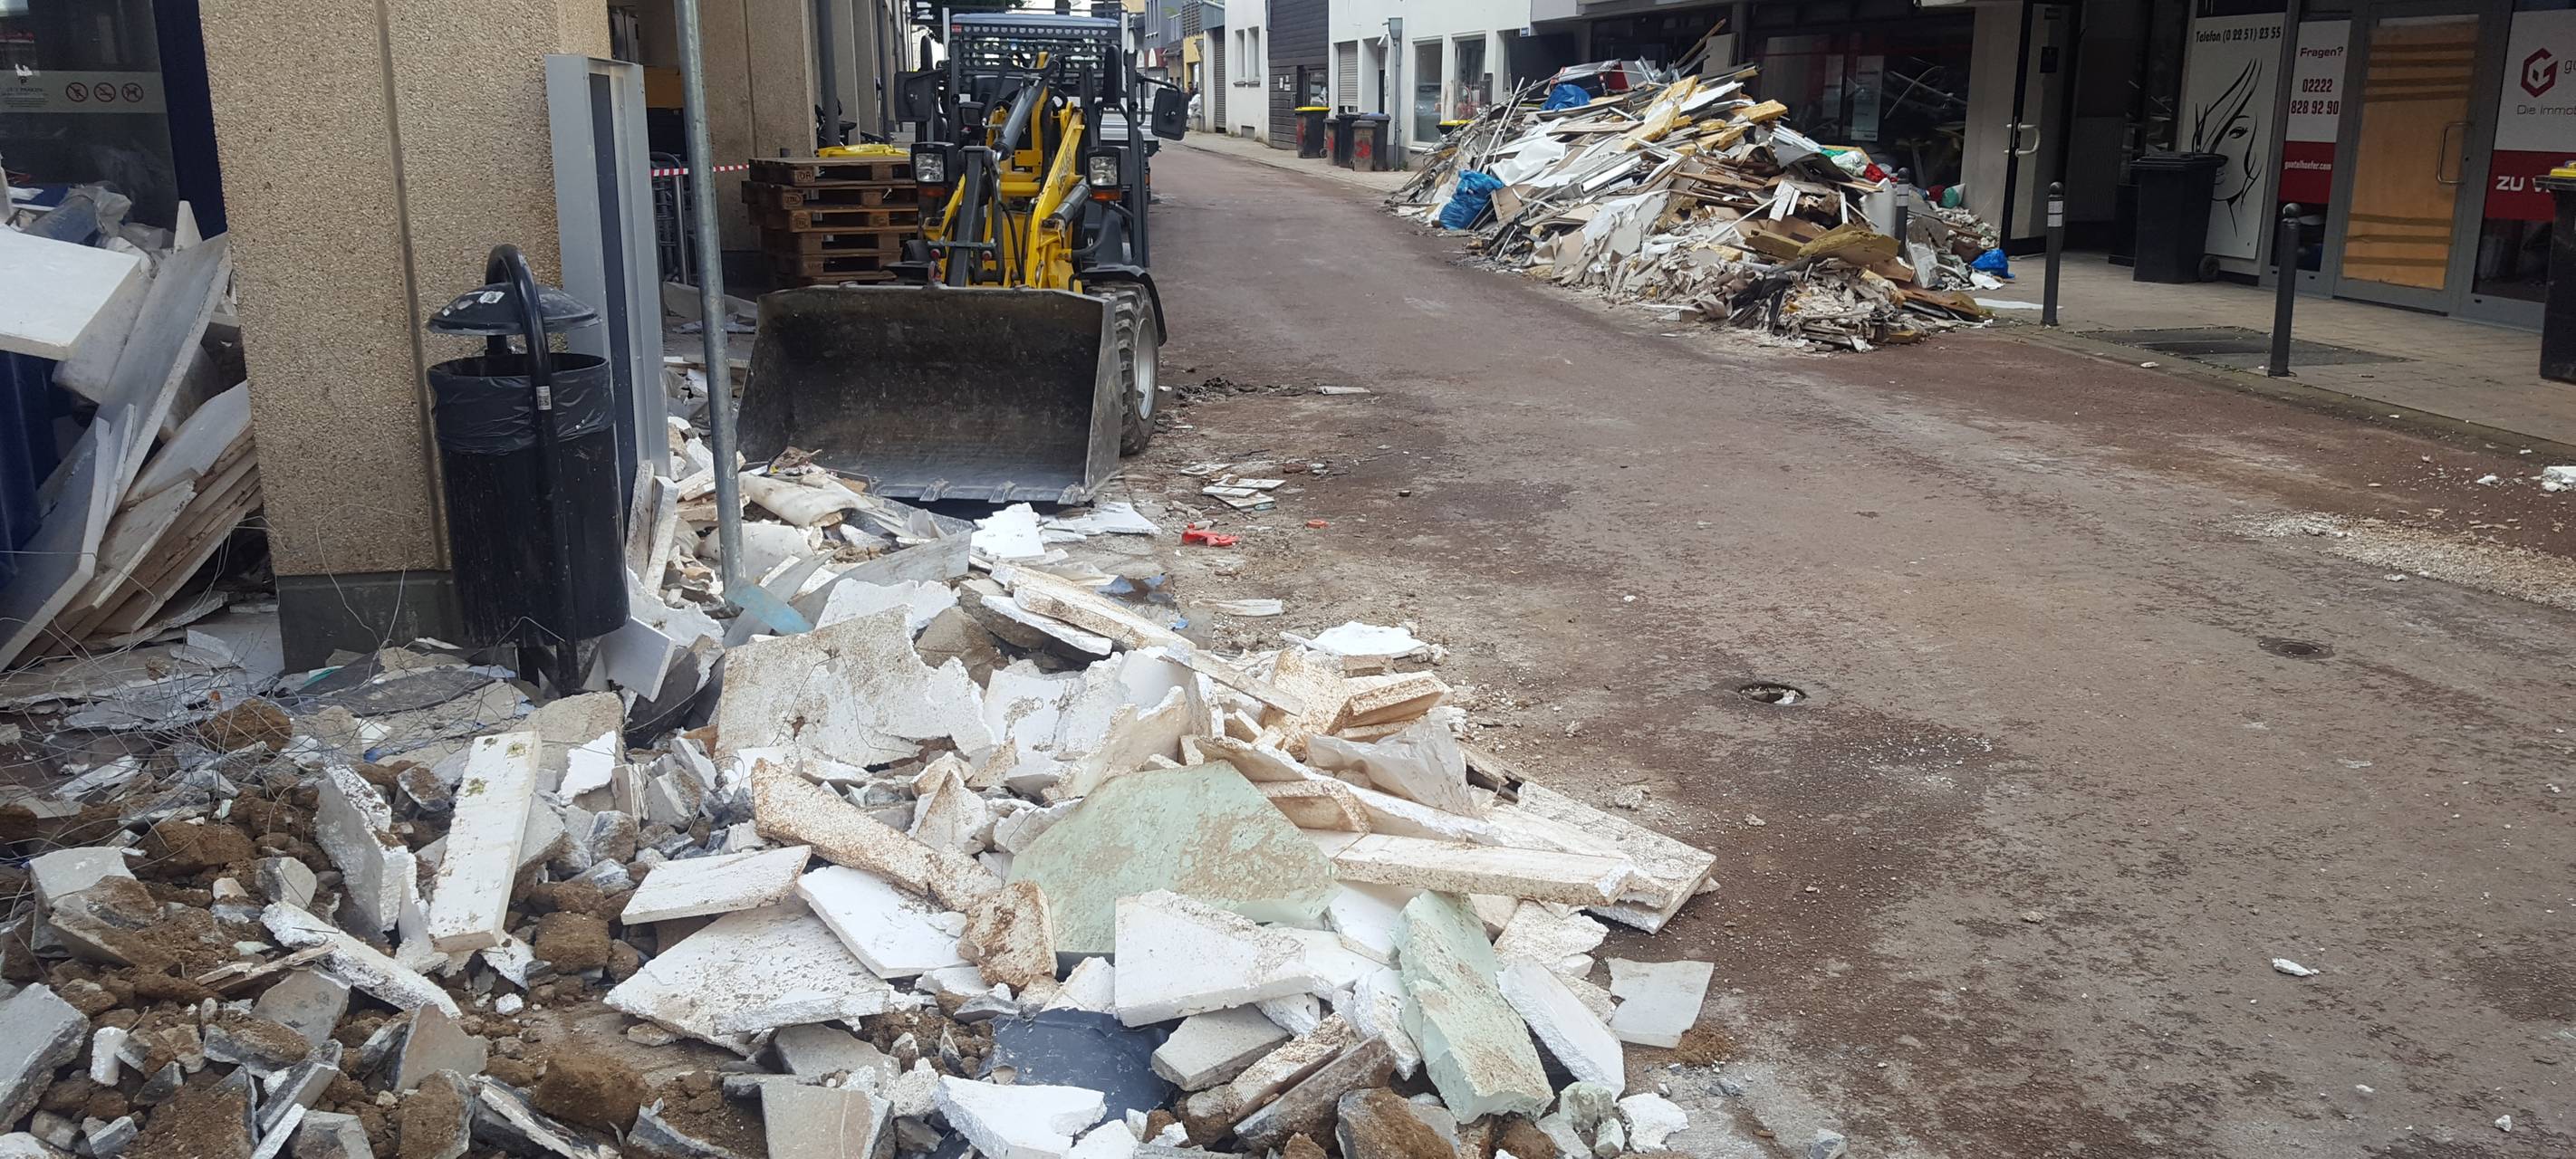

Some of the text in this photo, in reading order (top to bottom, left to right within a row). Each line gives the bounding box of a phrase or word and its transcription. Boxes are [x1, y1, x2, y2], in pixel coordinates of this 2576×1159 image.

[2196, 30, 2222, 43] Telefon
[2232, 28, 2243, 41] 22
[2271, 26, 2282, 39] 55
[2300, 46, 2344, 59] Fragen?
[2302, 78, 2333, 92] 02222
[2290, 100, 2340, 115] 828 92 90
[2495, 176, 2525, 192] ZU
